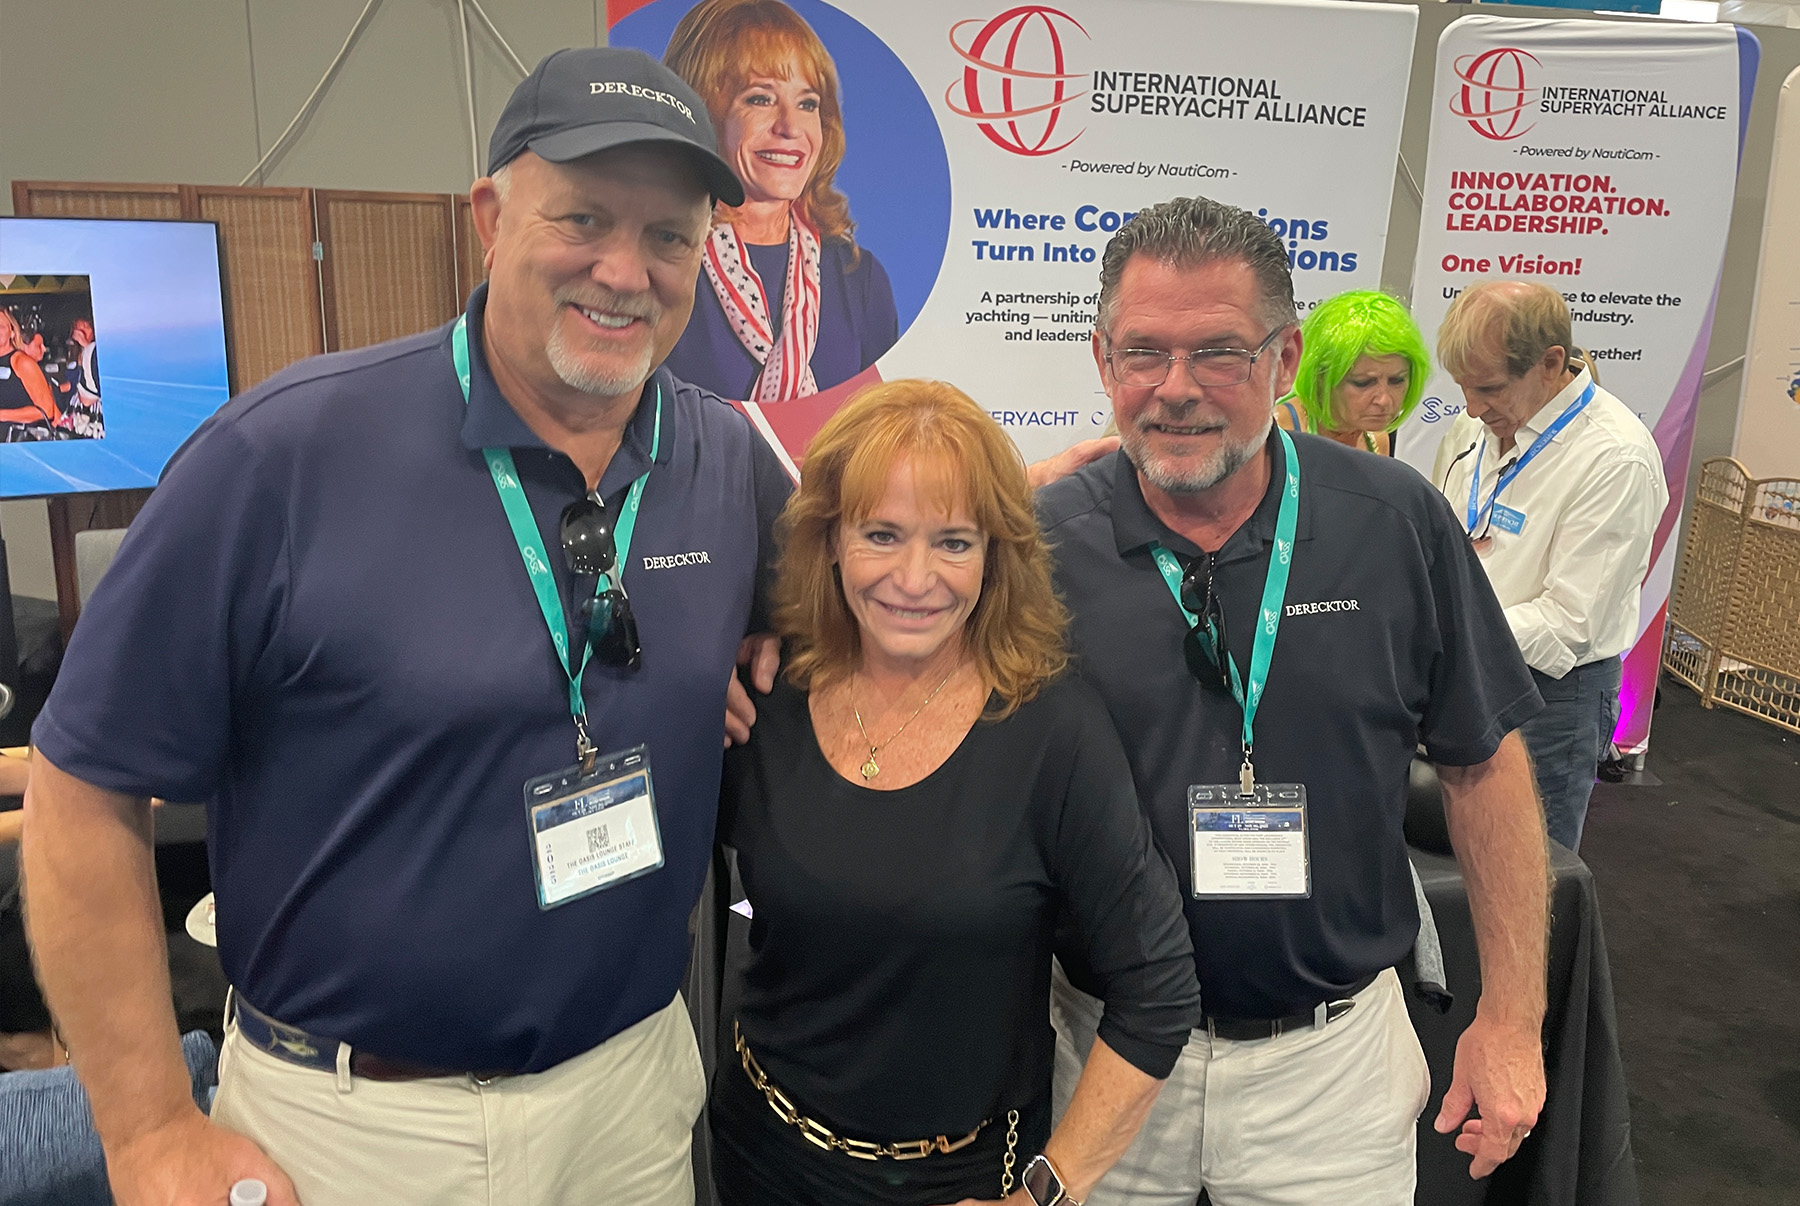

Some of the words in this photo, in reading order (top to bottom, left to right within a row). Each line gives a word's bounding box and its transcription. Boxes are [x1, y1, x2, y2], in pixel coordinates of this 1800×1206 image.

[1093, 70, 1281, 100] INTERNATIONAL
[589, 82, 696, 124] DERECKTOR
[1542, 86, 1668, 104] INTERNATIONAL
[1090, 92, 1249, 119] SUPERYACHT
[1254, 101, 1367, 127] ALLIANCE
[1540, 100, 1646, 117] SUPERYACHT
[1649, 103, 1727, 120] ALLIANCE
[1520, 145, 1573, 158] Powered
[1575, 146, 1591, 160] by
[1592, 148, 1653, 160] NautiCom
[1070, 159, 1134, 175] Powered
[1137, 161, 1157, 178] by
[1157, 163, 1229, 178] NautiCom
[1451, 171, 1617, 193] INNOVATION.
[1449, 192, 1670, 217] COLLABORATION.
[973, 208, 1066, 230] Where
[1446, 213, 1609, 235] LEADERSHIP.
[972, 240, 1034, 261] Turn
[1043, 242, 1096, 263] Into
[1441, 254, 1491, 274] One
[1498, 254, 1582, 276] Vision!
[980, 291, 992, 303] A
[996, 292, 1080, 307] partnership
[1083, 292, 1098, 304] of
[1580, 292, 1596, 303] to
[1599, 292, 1653, 305] elevate
[1656, 294, 1682, 306] the
[966, 309, 1030, 325] yachting
[1571, 308, 1634, 326] industry.
[1005, 329, 1032, 341] and
[1036, 329, 1092, 342] leadersh
[1589, 348, 1642, 361] gether!
[988, 411, 1079, 426] ERYACHT
[643, 551, 711, 570] DERECKTOR
[1285, 599, 1360, 617] DERECKTOR
